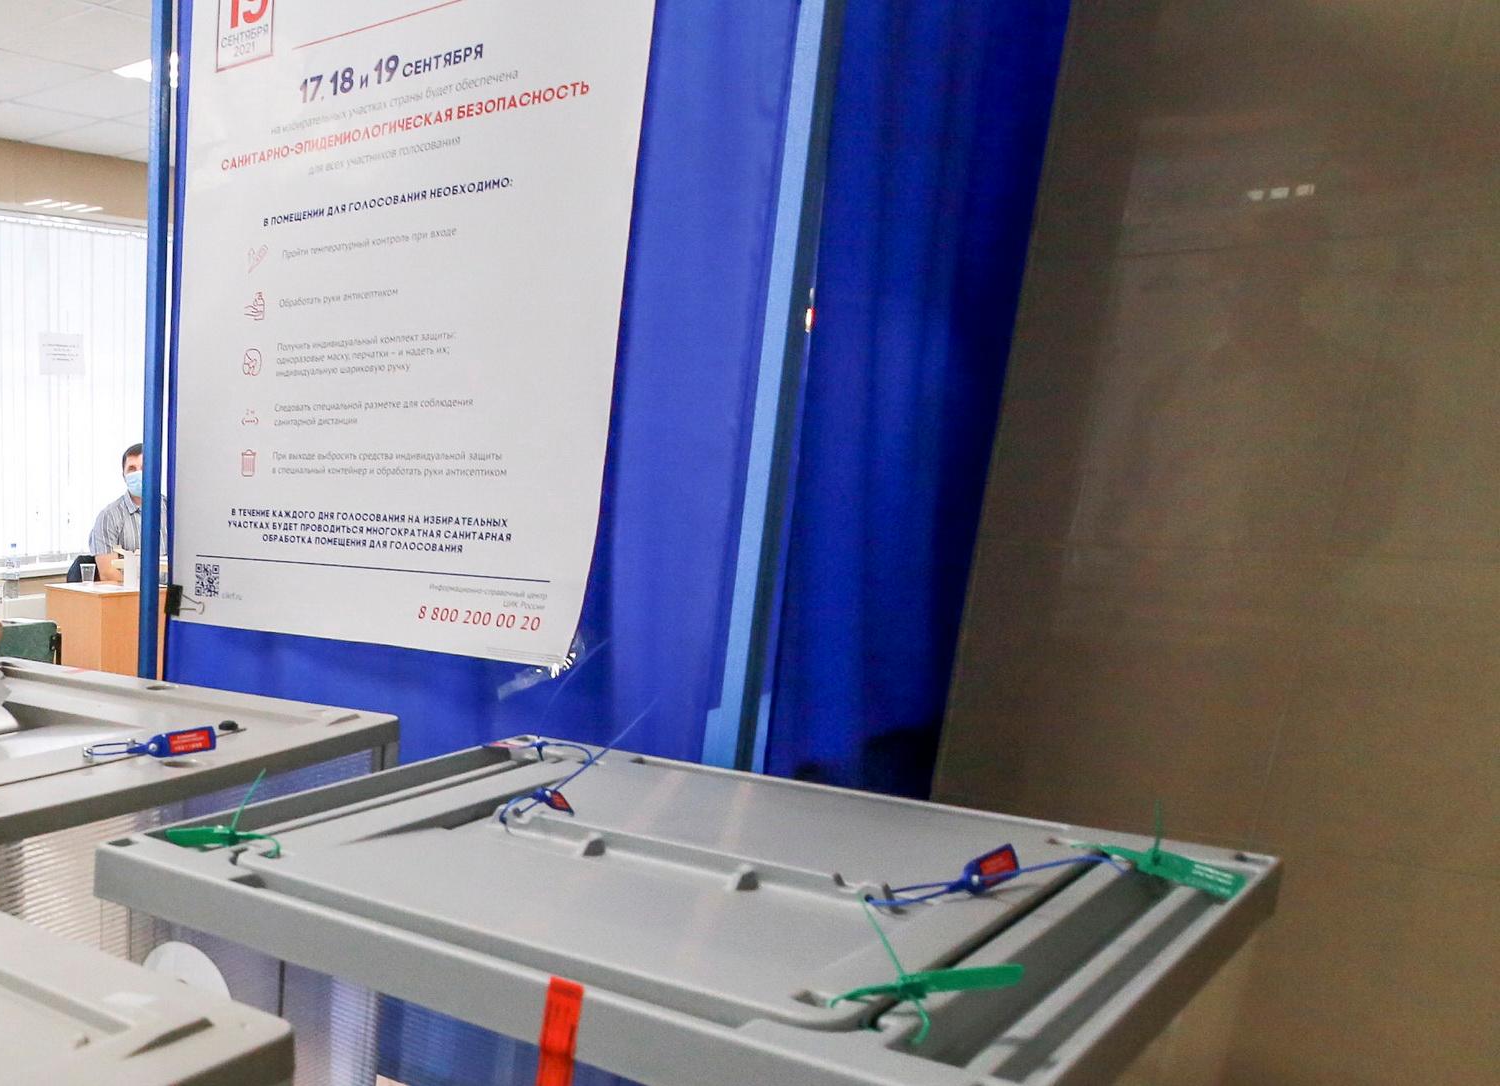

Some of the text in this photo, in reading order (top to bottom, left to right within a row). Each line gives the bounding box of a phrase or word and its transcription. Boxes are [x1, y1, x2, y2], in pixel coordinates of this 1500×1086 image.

[329, 67, 355, 97] 18
[359, 74, 369, 90] и
[373, 54, 400, 85] 19
[402, 43, 484, 78] СЕНТЯБРЯ
[348, 101, 387, 122] участках
[389, 92, 424, 109] страны
[425, 83, 454, 101] будет
[455, 69, 519, 94] обеспечена
[220, 80, 591, 171] САНИТАРНО-ЭПИДЕМИОЛОГИЧЕСКАЯ БЕЗОПАСНОСТЬ
[308, 136, 461, 176] для всех участников голосования
[263, 177, 514, 227] В ПОМЕЩЕНИИ ДЛЯ ГОЛОСОВАНИЯ НЕОБХОДИМО:
[282, 249, 309, 260] Пройти
[372, 234, 410, 247] контроль
[411, 231, 428, 243] при
[430, 227, 458, 239] входе
[278, 287, 399, 309] Обработать руки антисептиком
[276, 342, 310, 351] Получить
[312, 336, 378, 349] индивидуальный
[380, 334, 418, 344] комплект
[352, 350, 388, 361] перчатки
[405, 347, 435, 357] надеть
[275, 362, 411, 377] индивидуальную шариковую ручку
[274, 398, 474, 412] Следовать специальной разметке для соблюдения
[274, 418, 358, 427] санитарной дистанции
[272, 451, 502, 464] При выходе выбросить средства индивидуальной защиты
[277, 466, 327, 477] специальный
[328, 466, 367, 477] контейнер
[376, 466, 422, 478] обработать
[423, 467, 443, 478] руки
[444, 468, 508, 477] антисептиком
[231, 508, 509, 528] В ТЕЧЕНИЕ КАЖДОГО ДНЯ ГОЛОСОВАНИЯ НА ИЗБИРАТЕЛЬНЫХ
[227, 520, 512, 542] УЧАСТКАХ БУДЕТ ПРОВОДИТЬСЯ МНОГОКРАТНАЯ САНИТАРНАЯ
[262, 533, 463, 553] ОБРАБОТКА ПОМЕЩЕНИЯ ДЛЯ ГОЛОСОВАНИЯ
[418, 605, 541, 631] 8 800 200 00 20
